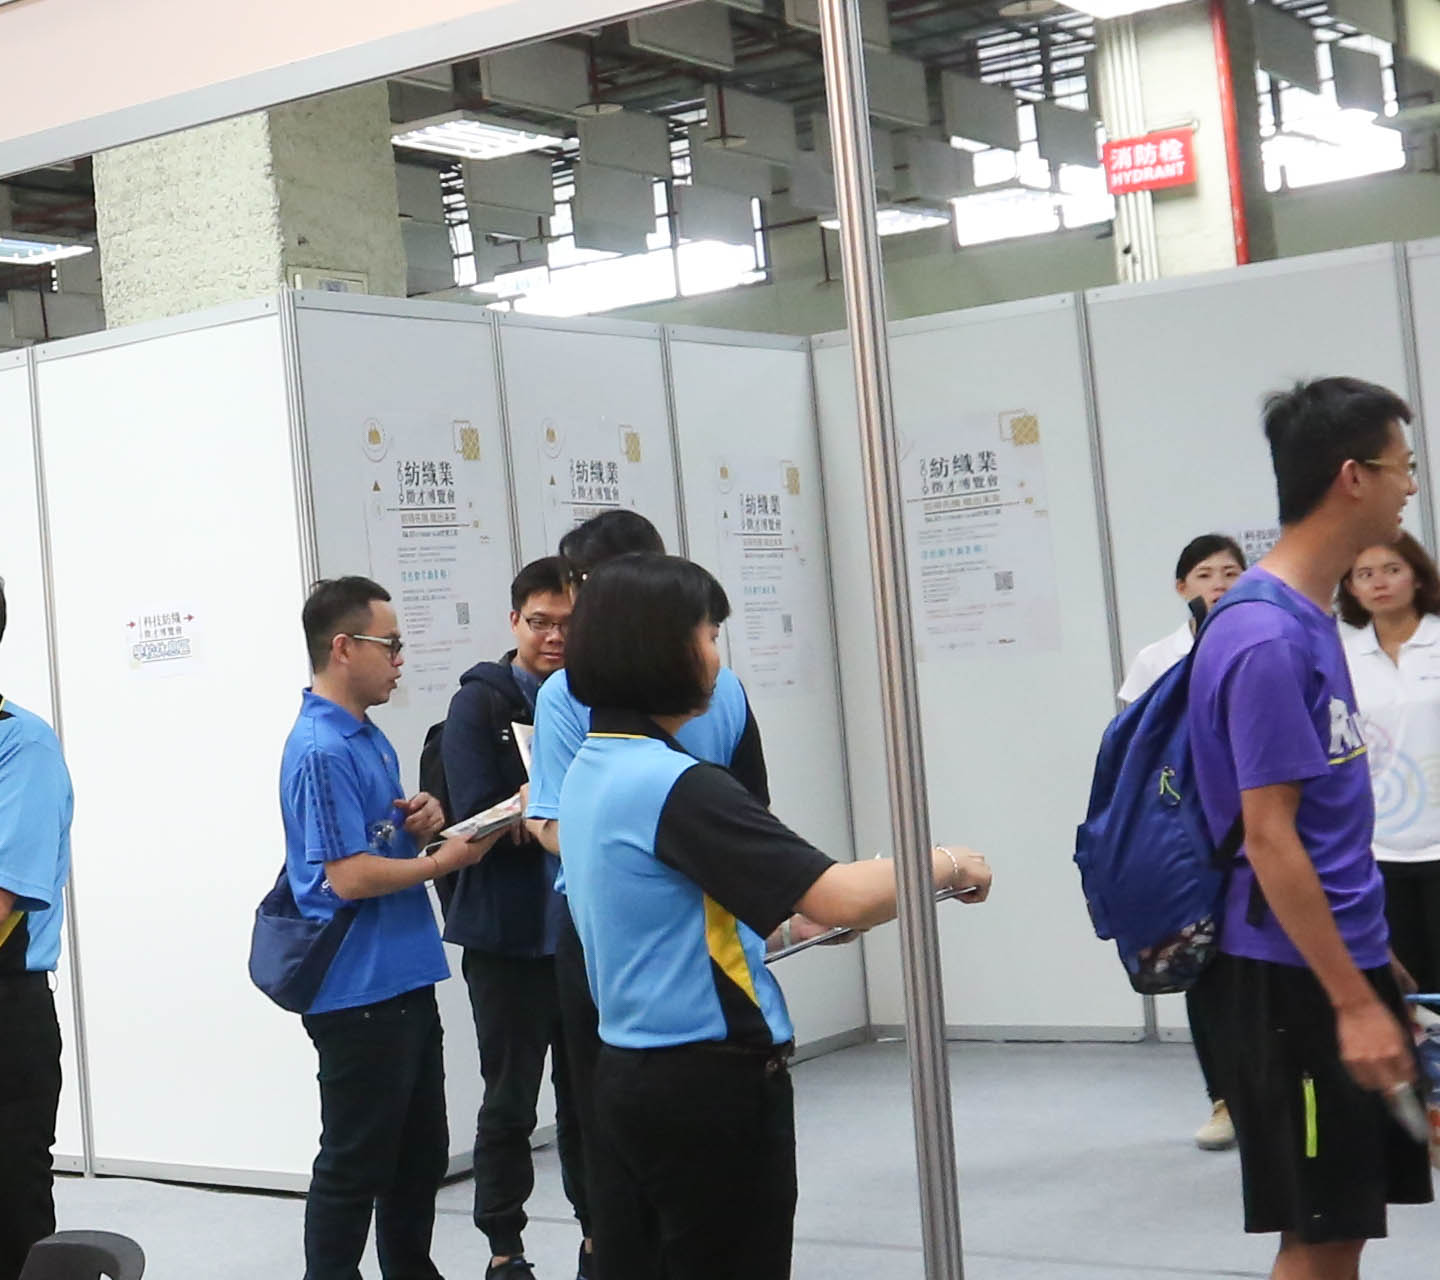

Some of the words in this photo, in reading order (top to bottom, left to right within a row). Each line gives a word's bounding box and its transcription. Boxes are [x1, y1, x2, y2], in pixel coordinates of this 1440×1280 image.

[1111, 161, 1186, 186] HYDRANT
[404, 460, 454, 487] 紡織業
[576, 459, 619, 485] 紡織業
[929, 449, 998, 479] 紡織業
